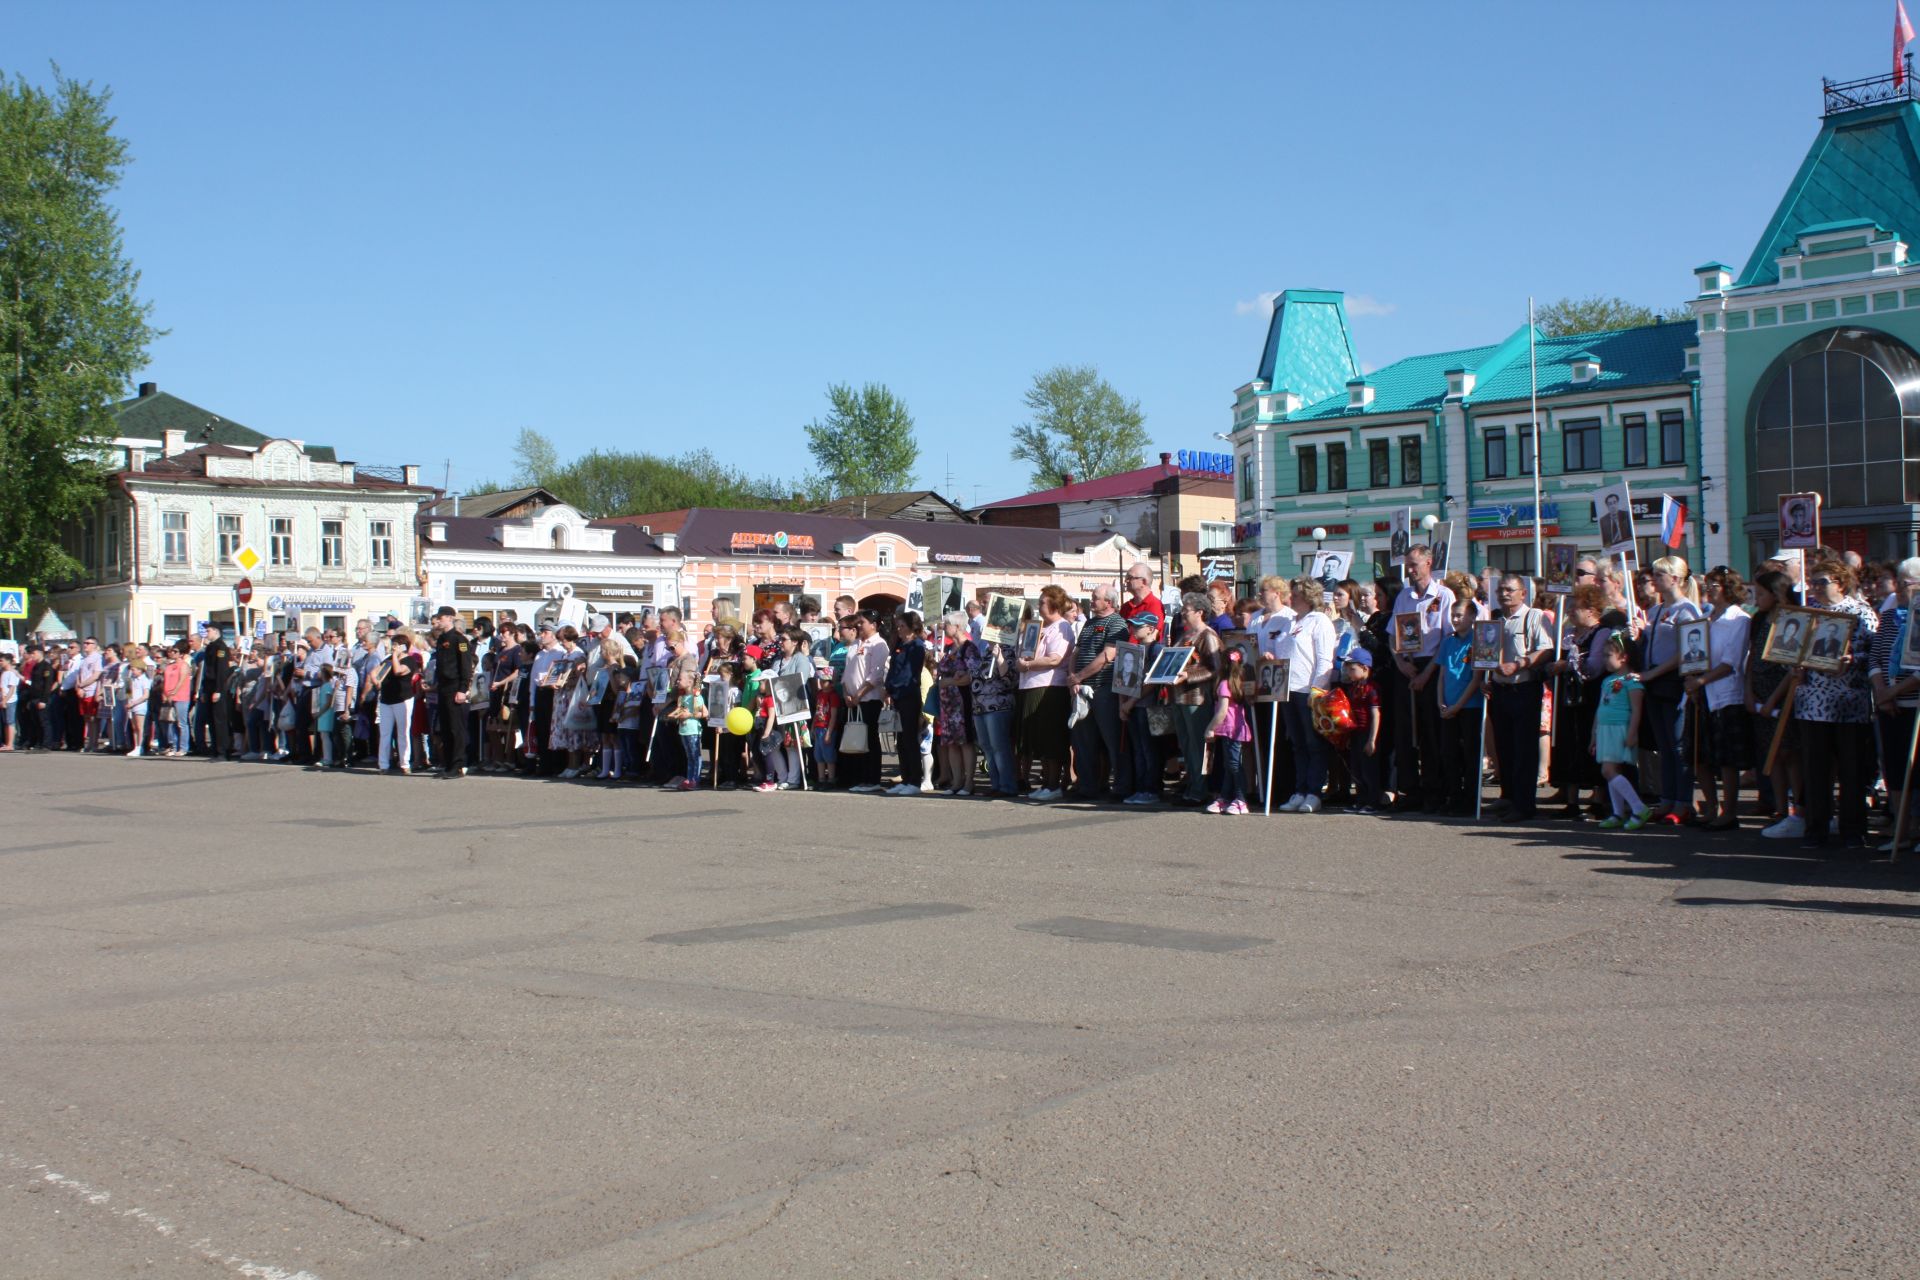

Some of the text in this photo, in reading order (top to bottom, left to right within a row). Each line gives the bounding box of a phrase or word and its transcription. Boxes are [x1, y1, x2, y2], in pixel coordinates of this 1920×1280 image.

[731, 532, 815, 547] АПТЕКА ВИТА
[470, 585, 507, 594] KARAOKE
[543, 583, 574, 599] EVO
[601, 588, 644, 597] LOUNGE BAR
